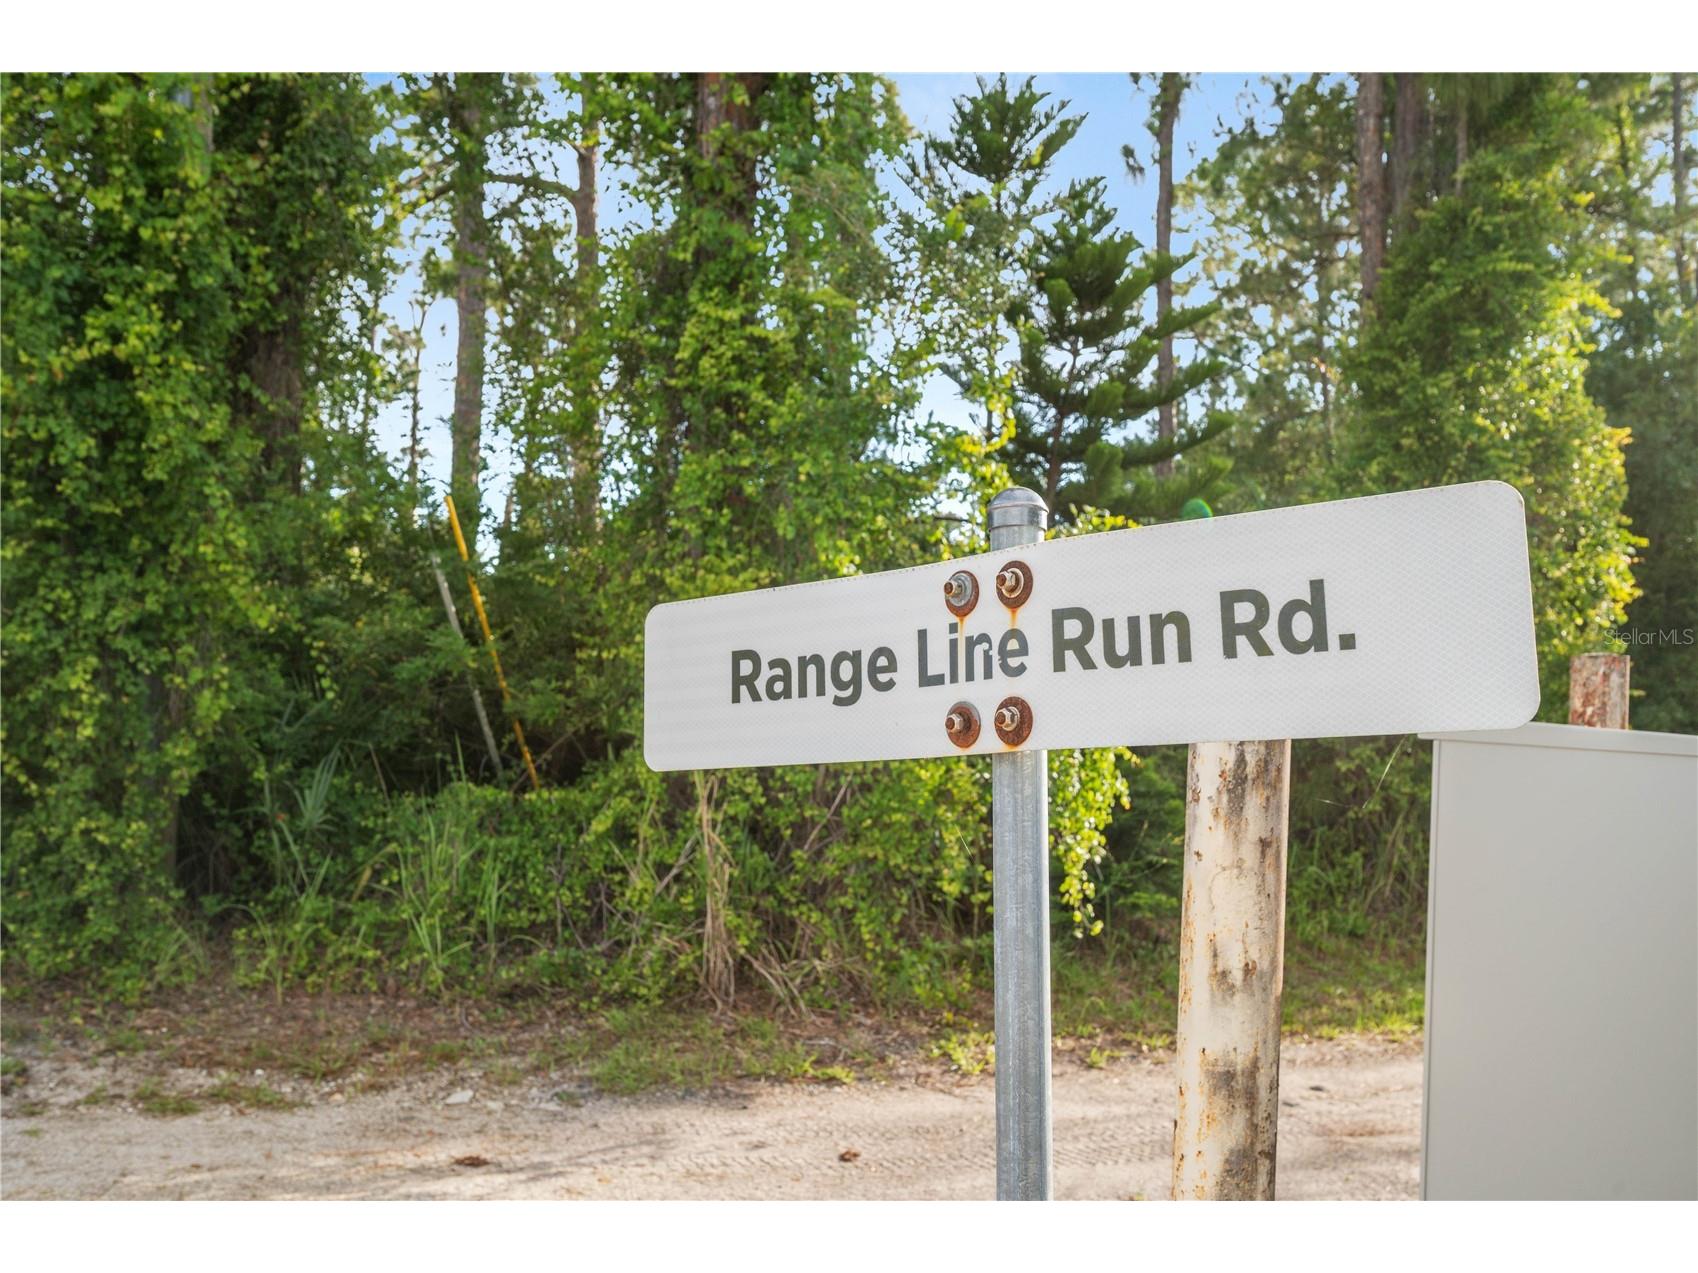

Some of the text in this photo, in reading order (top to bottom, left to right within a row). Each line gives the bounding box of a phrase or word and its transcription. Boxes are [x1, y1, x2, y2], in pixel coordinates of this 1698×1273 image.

[731, 579, 1355, 706] Range Line Run Rd.
